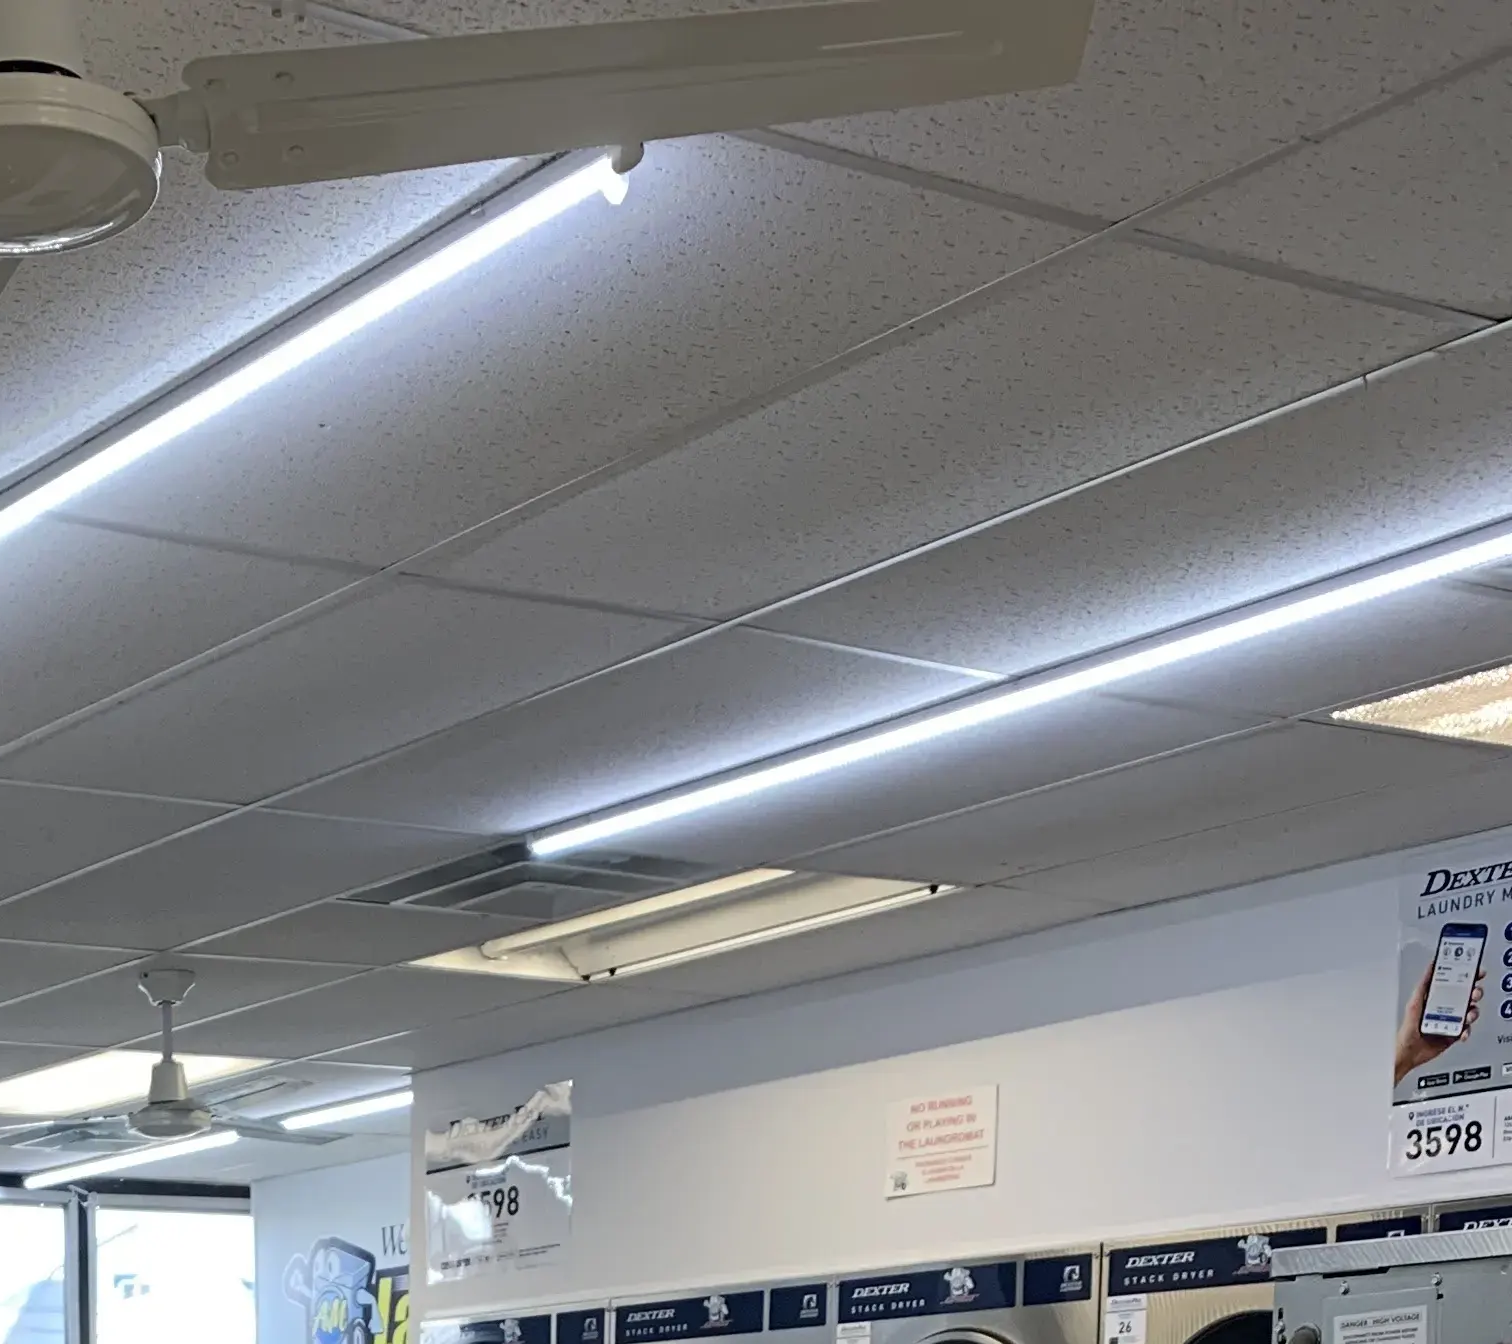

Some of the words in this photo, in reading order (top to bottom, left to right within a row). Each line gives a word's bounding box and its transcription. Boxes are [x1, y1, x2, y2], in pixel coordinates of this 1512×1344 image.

[1420, 861, 1512, 897] DEXTE
[1418, 889, 1496, 919] LAUNDRY
[928, 1095, 972, 1111] RUNNING
[923, 1114, 964, 1129] PLAYING
[898, 1138, 917, 1151] THE
[1406, 1120, 1482, 1160] 3598
[466, 1186, 520, 1218] 598
[1125, 1251, 1196, 1269] DEXTER
[1123, 1273, 1164, 1287] STACK
[1172, 1268, 1214, 1282] DRYER
[852, 1282, 910, 1299] DEXTER
[626, 1307, 676, 1323] DEXTER
[850, 1302, 885, 1315] STACK
[1118, 1320, 1132, 1334] 26
